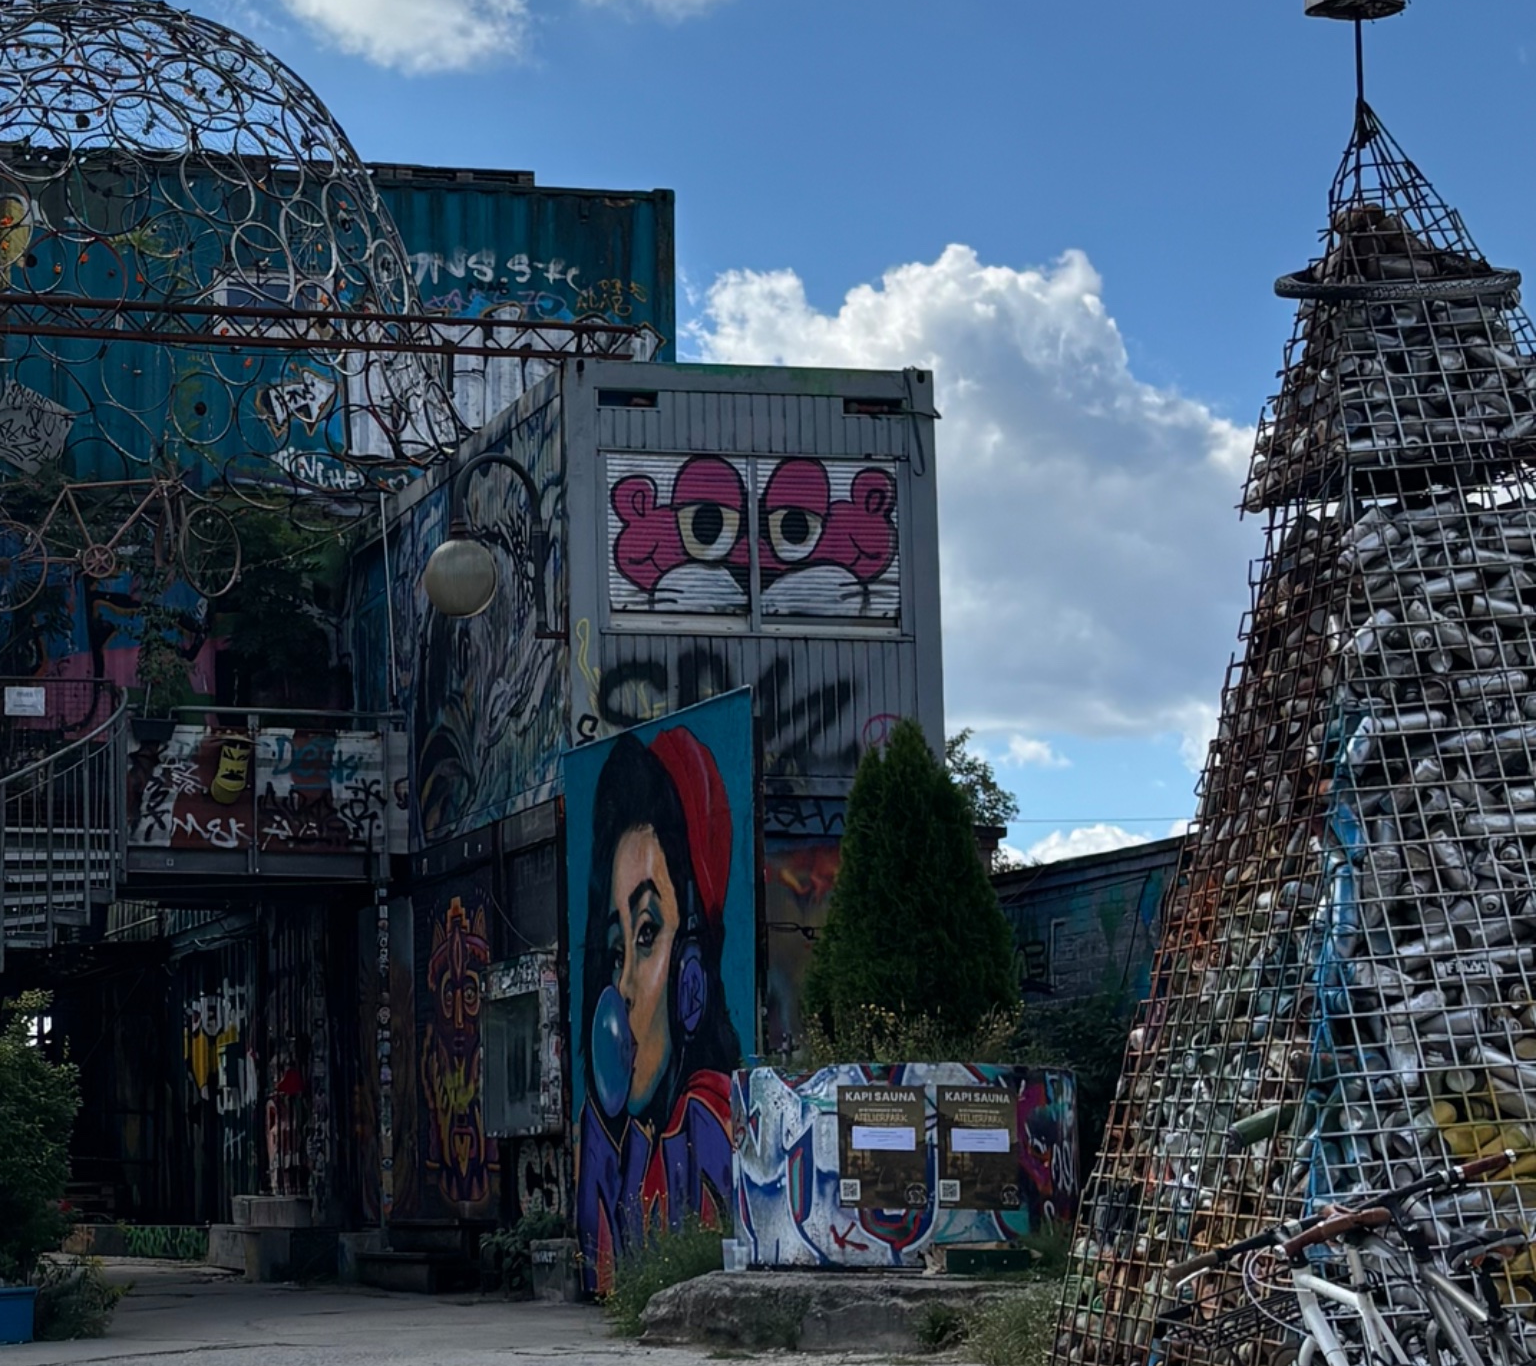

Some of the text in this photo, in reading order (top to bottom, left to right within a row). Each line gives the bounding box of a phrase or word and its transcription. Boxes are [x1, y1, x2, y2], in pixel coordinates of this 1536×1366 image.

[845, 1091, 917, 1103] KAPI SAUNA
[944, 1091, 1011, 1105] KAPI SAUNA
